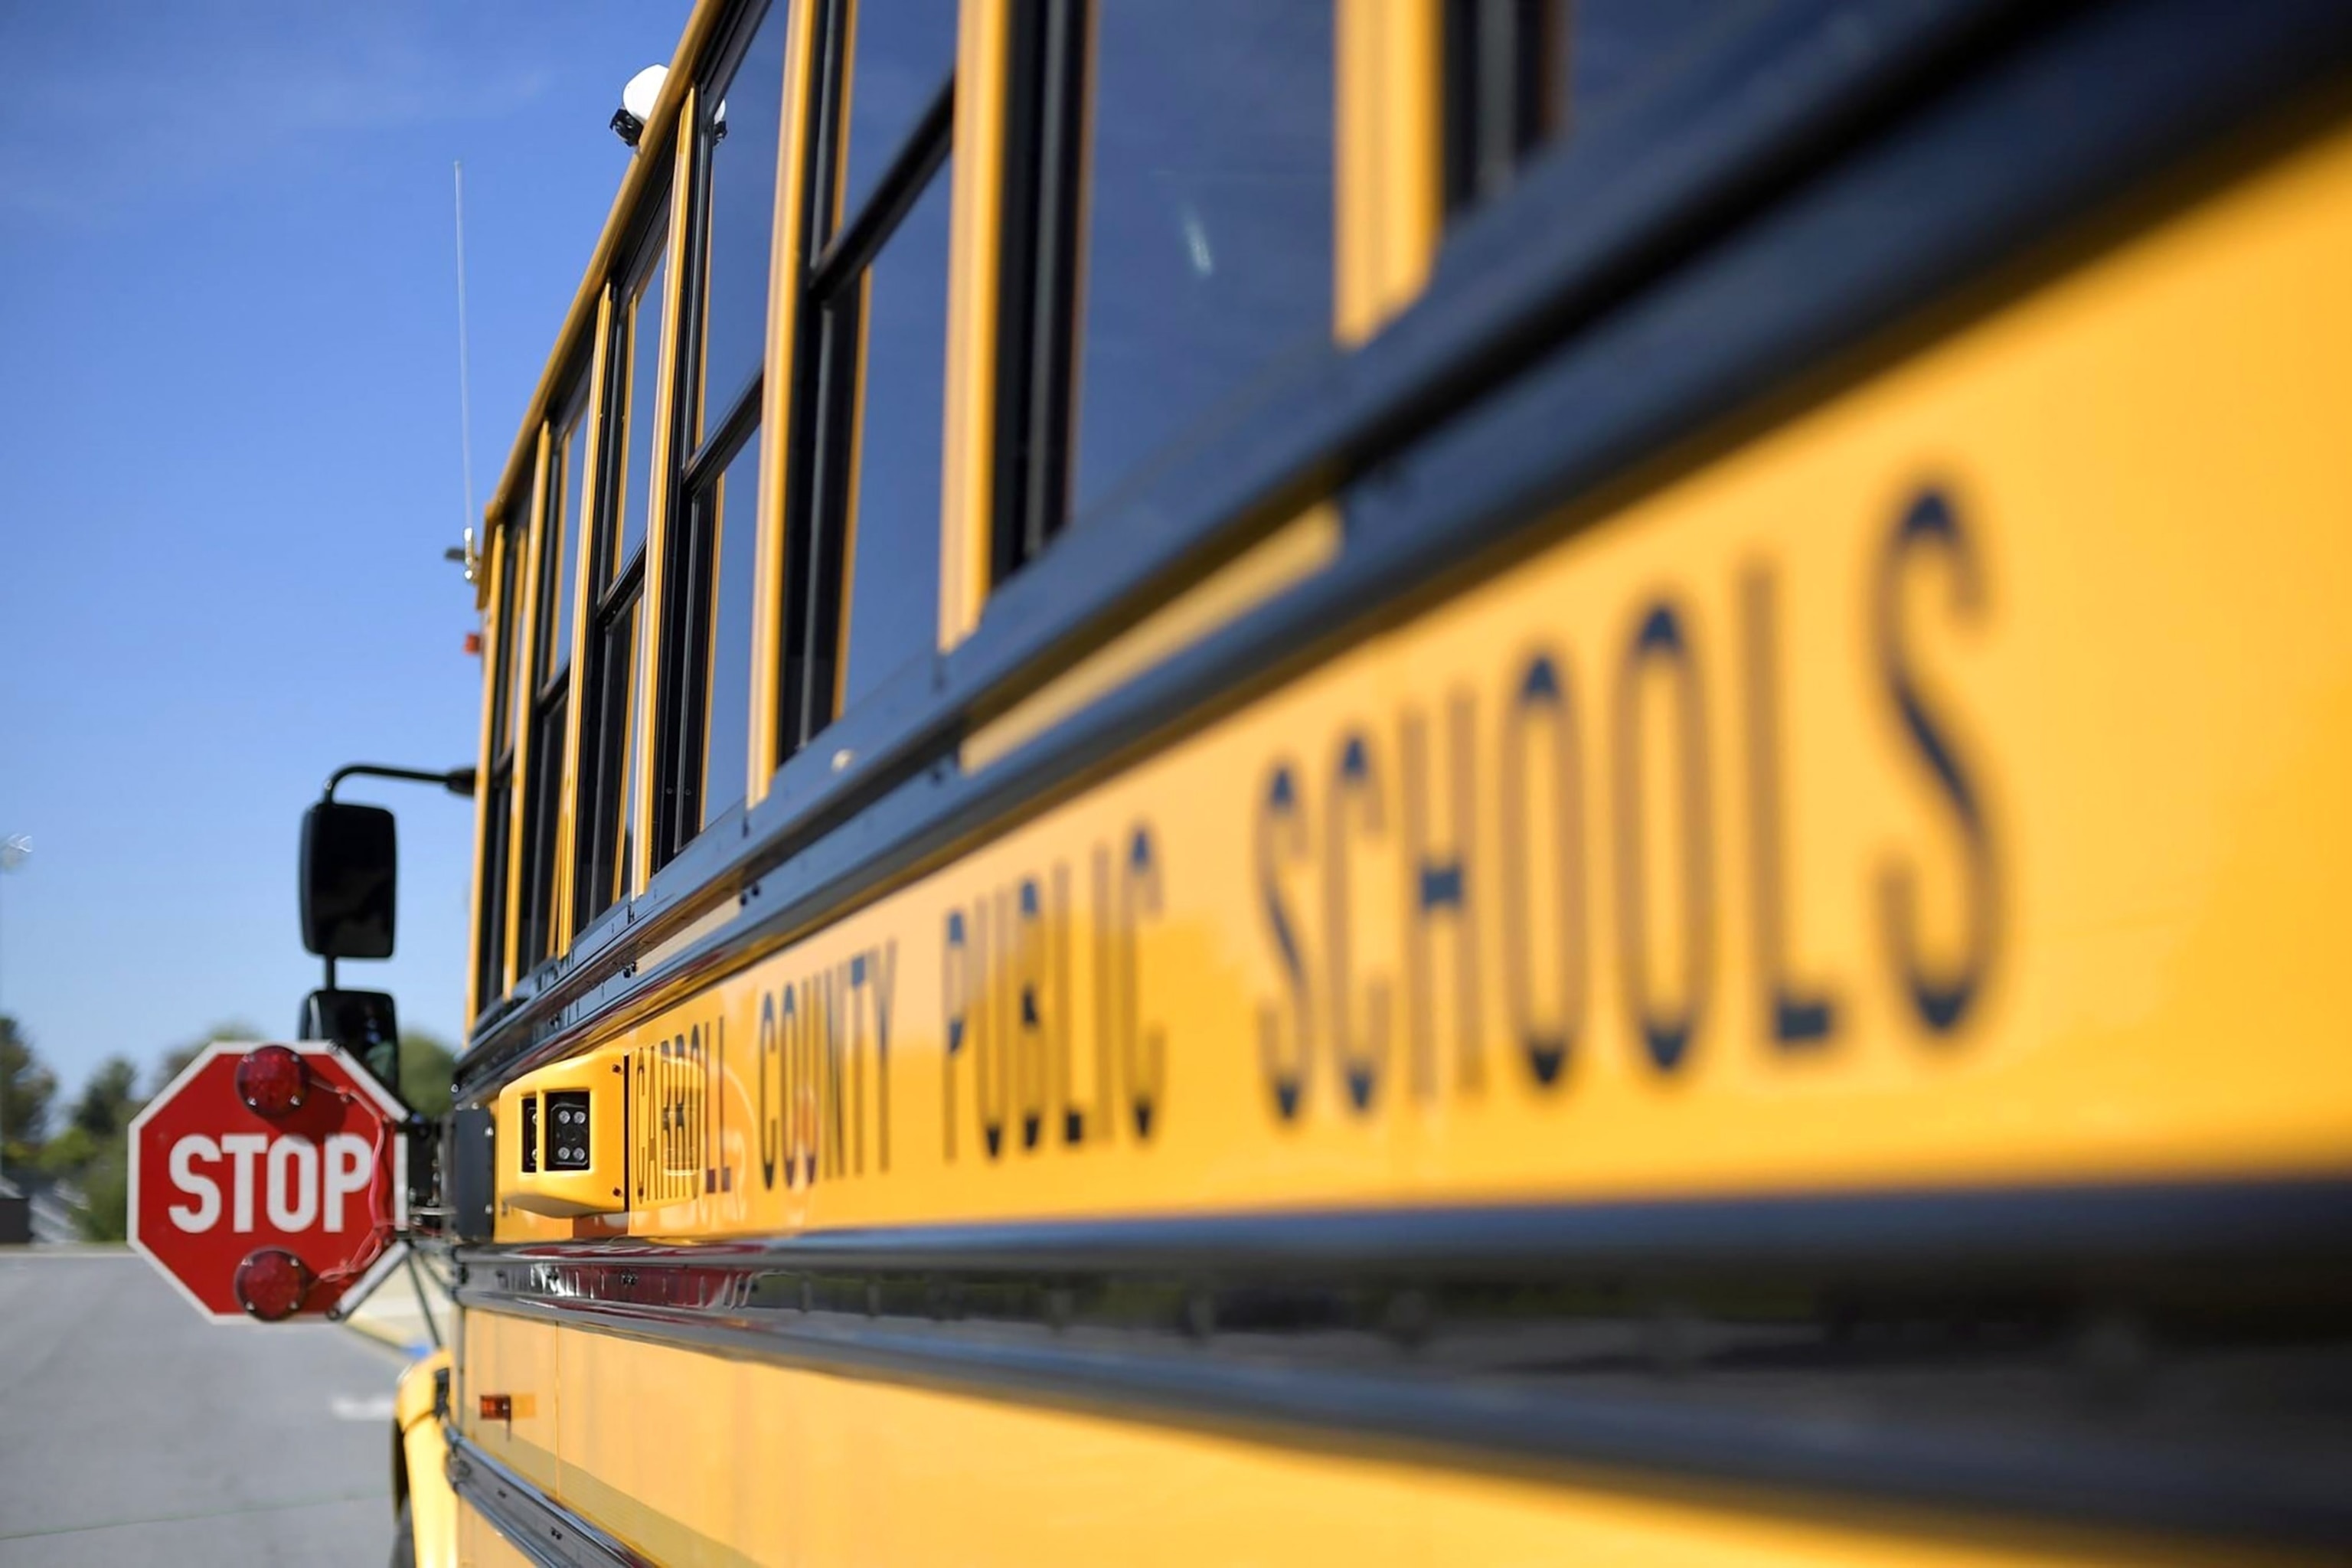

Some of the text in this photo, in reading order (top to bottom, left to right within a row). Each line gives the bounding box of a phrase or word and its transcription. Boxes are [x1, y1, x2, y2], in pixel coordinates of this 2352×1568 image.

[636, 476, 2007, 1204] CARROLL COUNTY PUBLIC SCHOOLS
[168, 1133, 374, 1233] STOP
